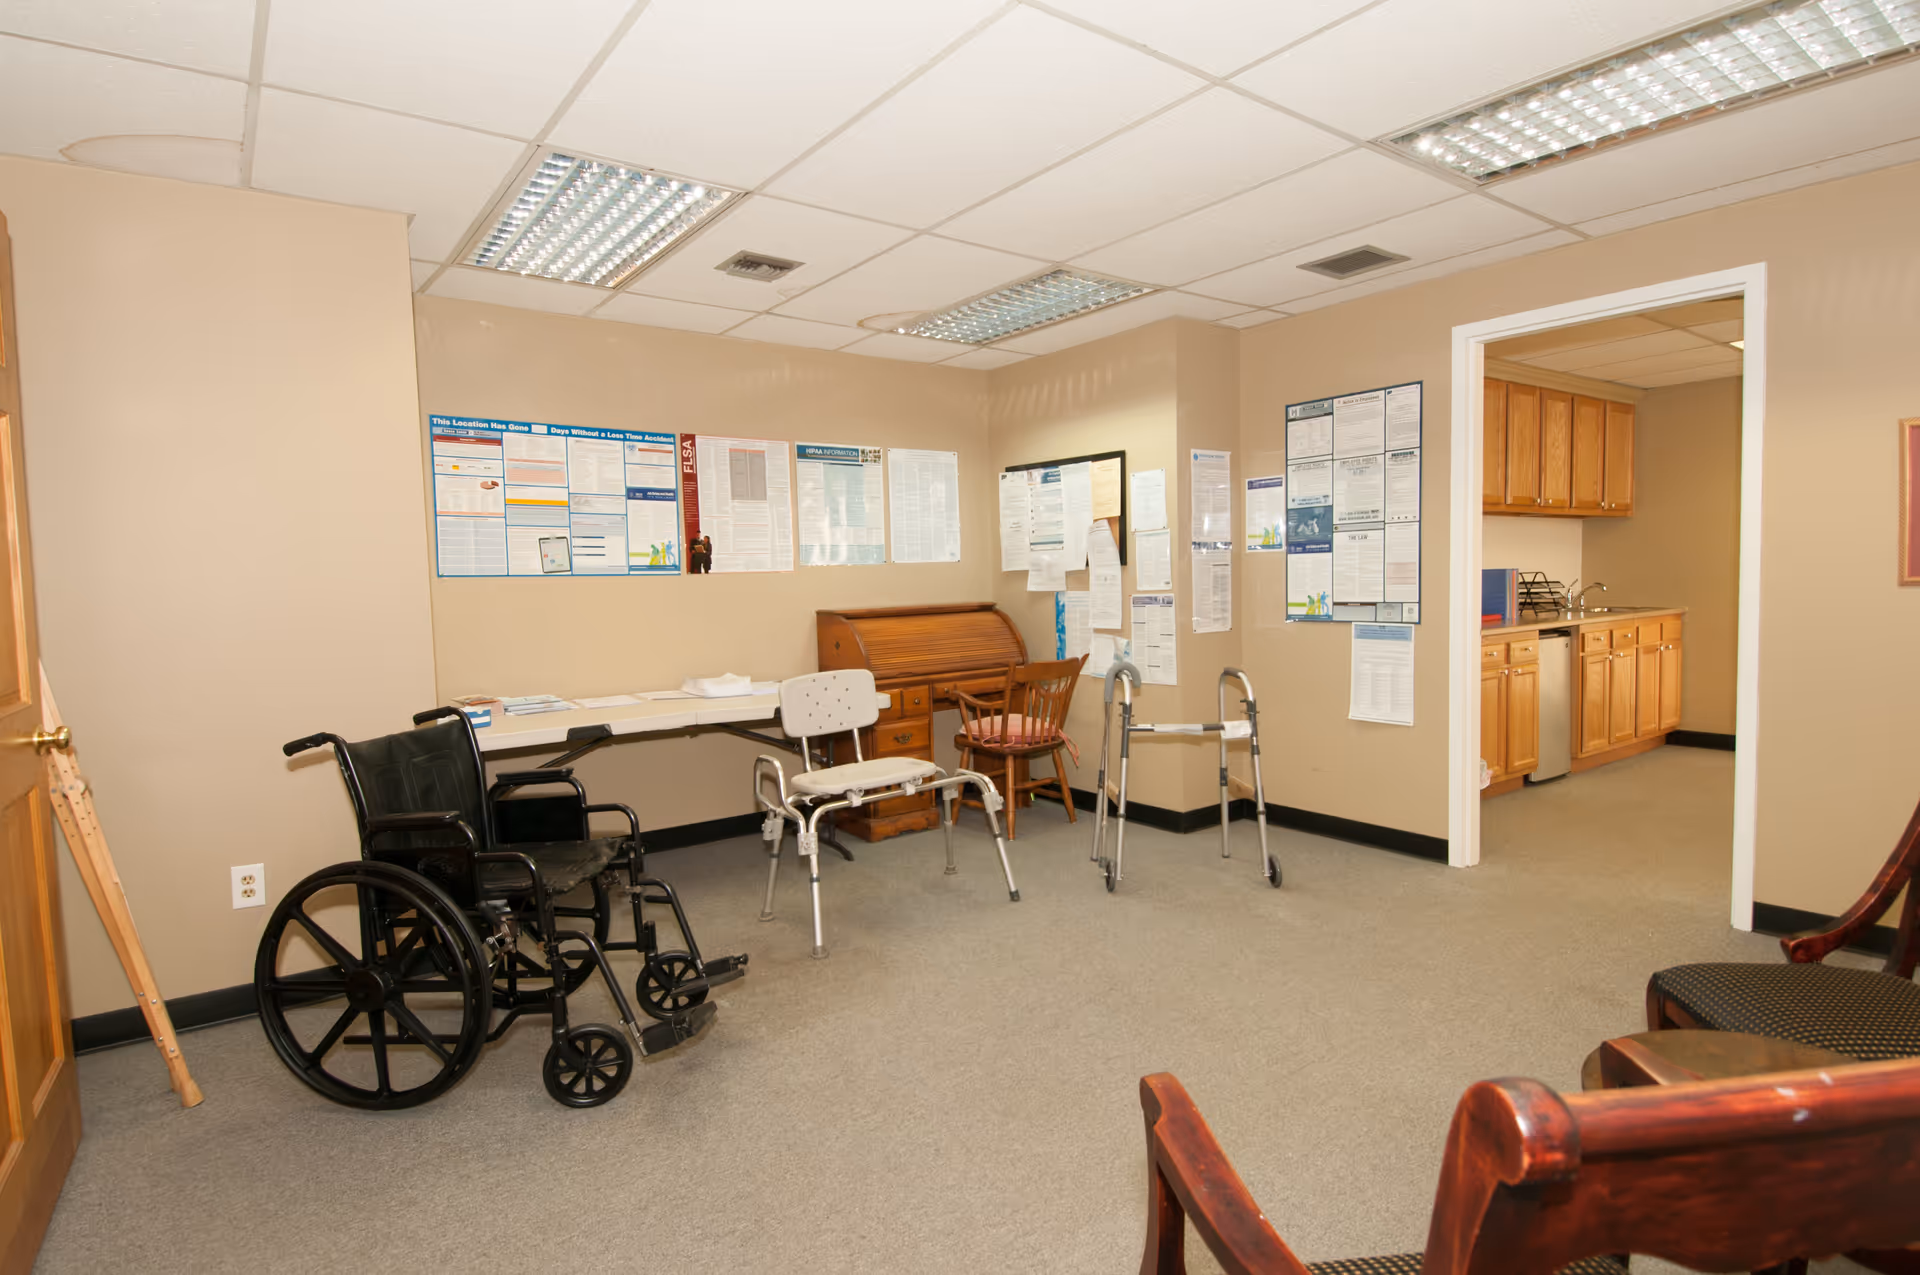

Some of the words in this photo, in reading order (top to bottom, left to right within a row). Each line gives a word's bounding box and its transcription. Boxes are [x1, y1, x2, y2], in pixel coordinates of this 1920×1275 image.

[453, 419, 489, 428] Location
[490, 422, 506, 430] Has
[508, 423, 529, 431] Gone
[550, 427, 569, 435] Days
[571, 429, 599, 437] Without
[644, 435, 674, 443] Accident
[682, 440, 693, 473] FLSA
[823, 449, 858, 457] INFORMATION
